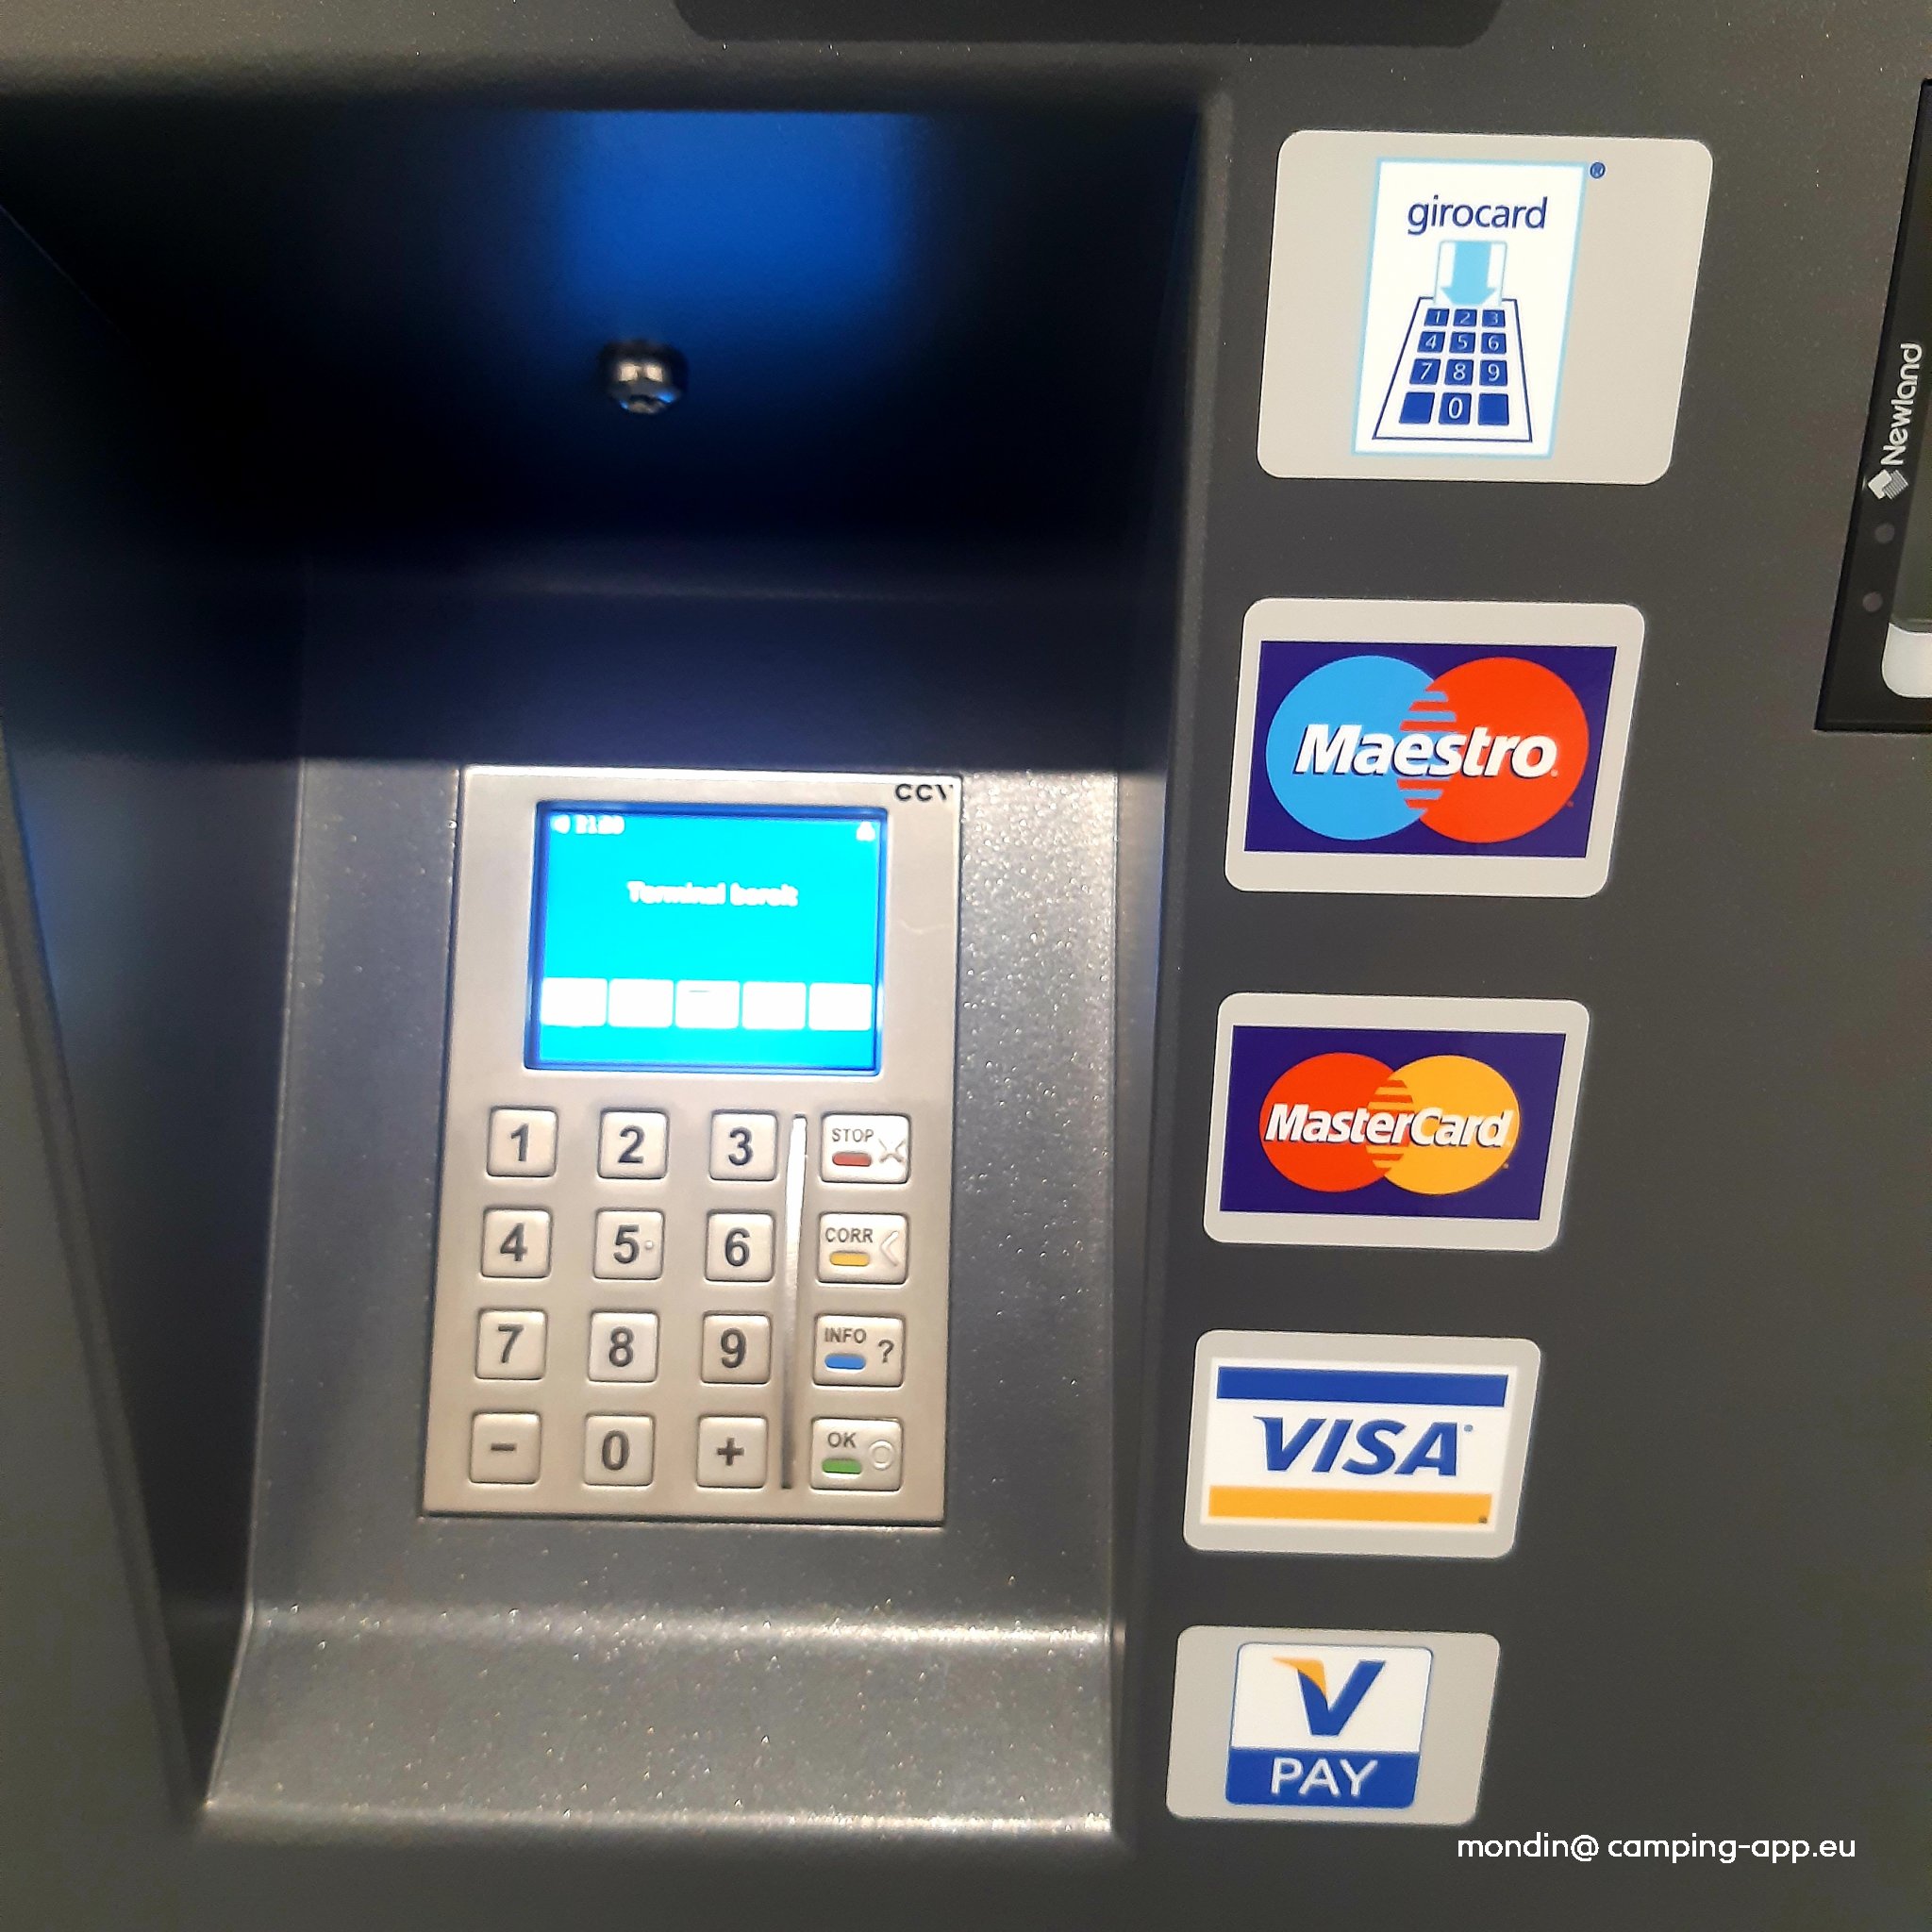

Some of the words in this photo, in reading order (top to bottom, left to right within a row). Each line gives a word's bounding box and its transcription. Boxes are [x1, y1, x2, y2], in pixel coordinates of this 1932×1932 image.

[1407, 194, 1548, 236] girocard
[1459, 311, 1471, 325] 2
[1424, 334, 1437, 349] 4
[1457, 334, 1468, 350] 5
[1488, 335, 1499, 351] 6
[1420, 362, 1433, 380] 7
[1453, 362, 1466, 381] 8
[1488, 363, 1500, 382] 9
[1448, 397, 1463, 419] 0
[1880, 342, 1923, 466] Newland
[1292, 724, 1558, 778] Maestro
[510, 1123, 530, 1162] 1
[617, 1124, 645, 1164] 2
[831, 1127, 874, 1143] STOP
[1264, 1103, 1514, 1148] MasterCard
[728, 1126, 753, 1166] 3
[499, 1223, 528, 1262] 4
[613, 1224, 640, 1264] 5
[724, 1227, 751, 1267] 6
[824, 1227, 874, 1243] CORR
[497, 1324, 525, 1364] 7
[608, 1326, 634, 1368] 8
[720, 1327, 747, 1368] 9
[824, 1327, 868, 1344] INFO
[877, 1339, 895, 1363] ?
[601, 1430, 629, 1471] 0
[827, 1432, 858, 1448] OK
[1253, 1415, 1458, 1476] VISA
[1273, 1656, 1387, 1737] V
[1271, 1757, 1378, 1798] PAY
